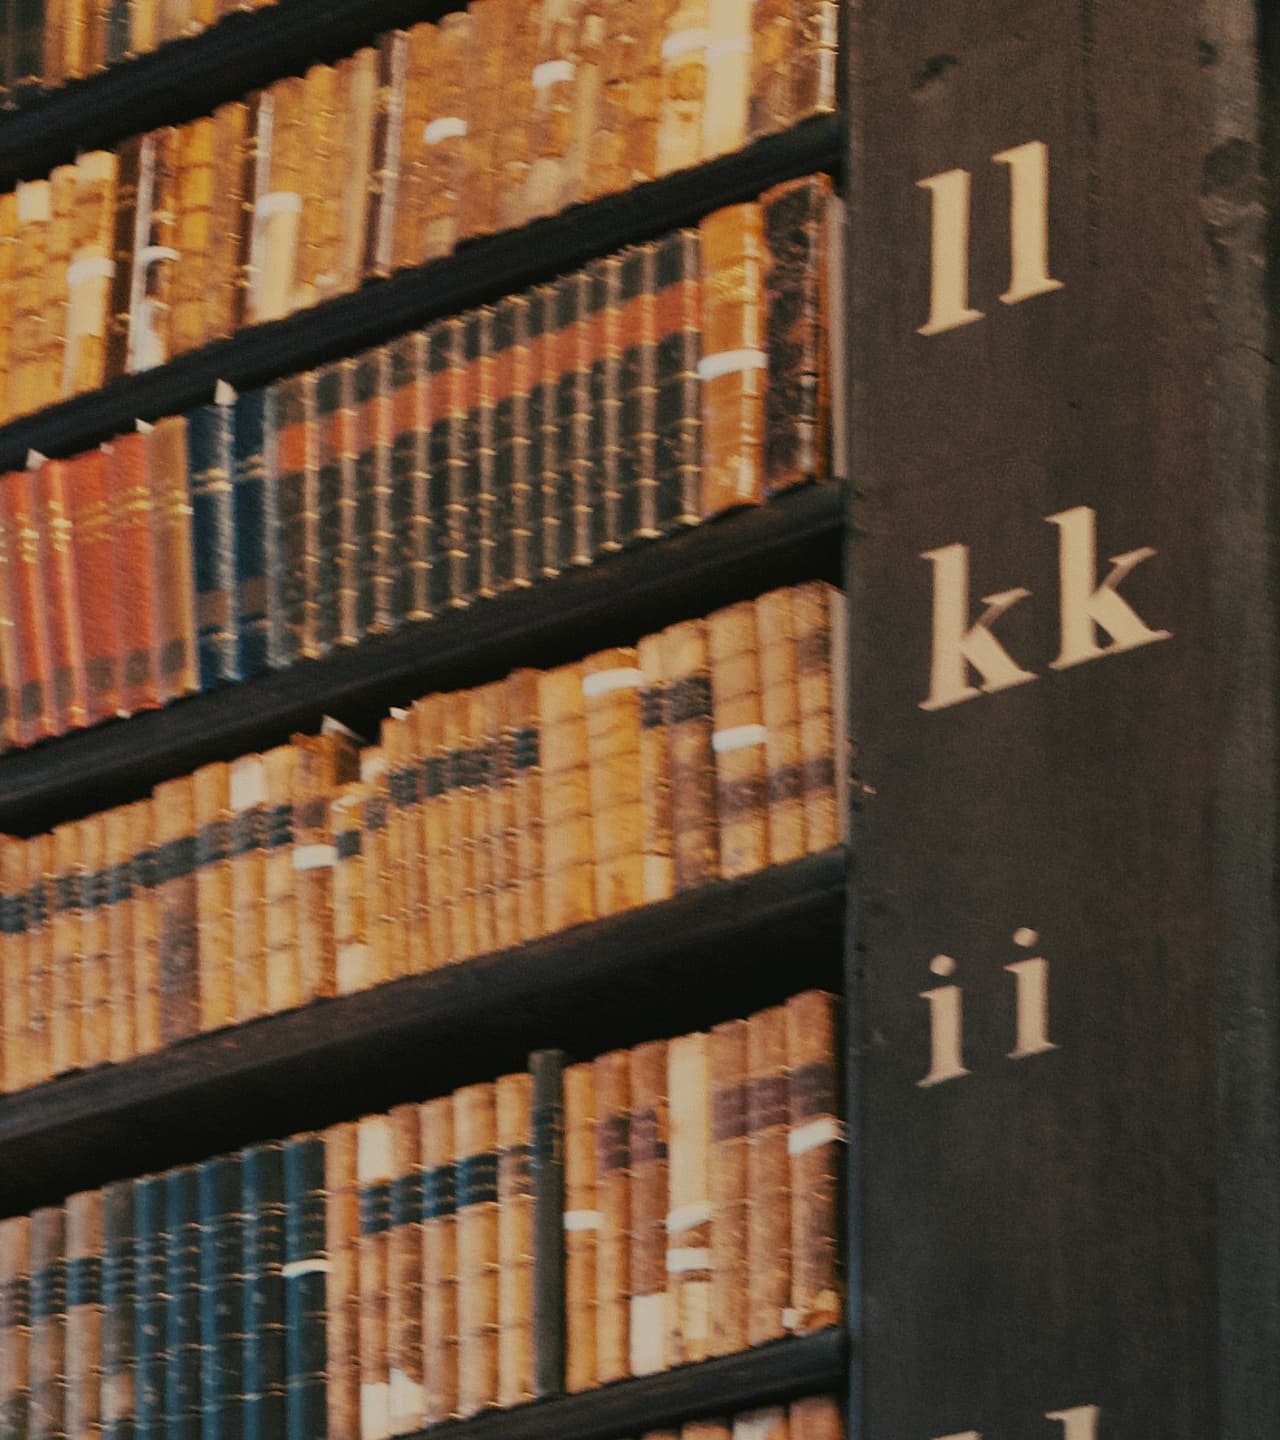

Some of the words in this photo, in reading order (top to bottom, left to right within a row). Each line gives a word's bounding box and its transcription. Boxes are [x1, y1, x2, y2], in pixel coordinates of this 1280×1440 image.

[917, 139, 1062, 338] ll
[919, 504, 1171, 712] kk
[920, 925, 1055, 1087] ii
